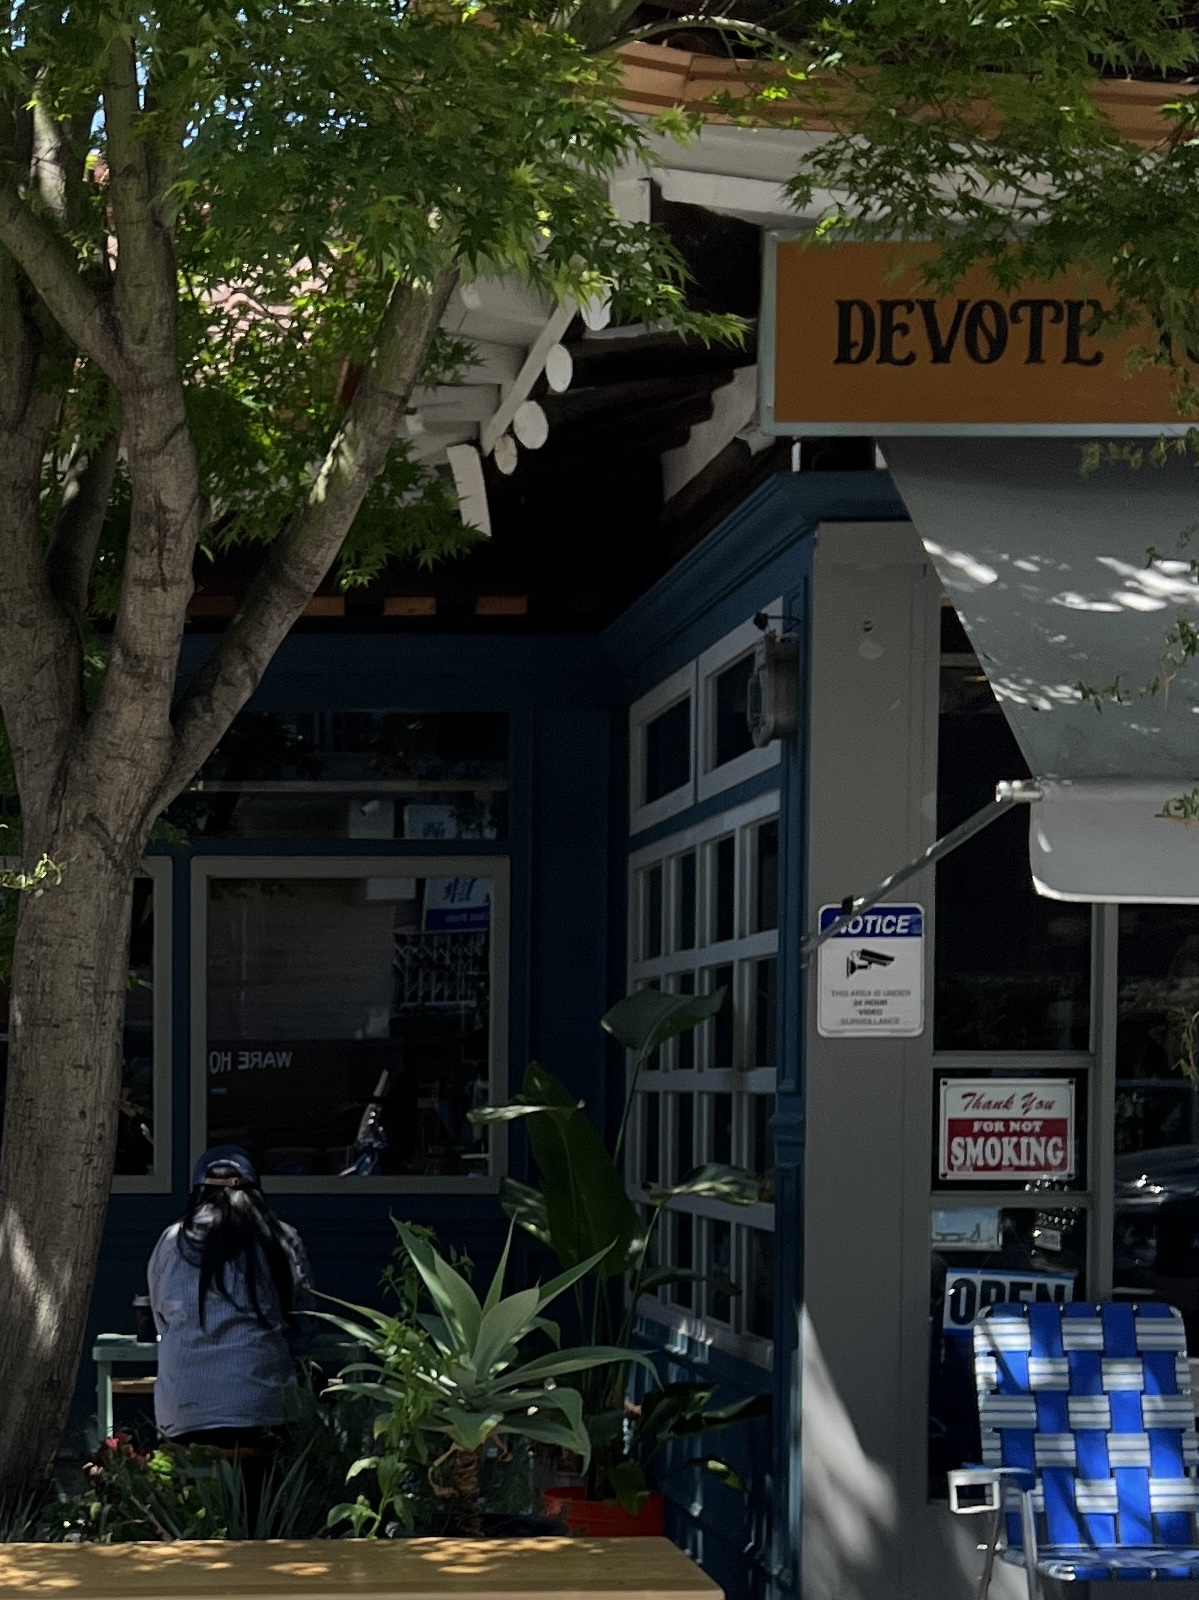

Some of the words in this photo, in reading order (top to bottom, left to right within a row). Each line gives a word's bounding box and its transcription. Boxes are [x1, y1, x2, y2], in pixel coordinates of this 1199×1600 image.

[833, 299, 1104, 366] DEVOTE
[961, 1092, 1016, 1112] Thank
[1021, 1092, 1055, 1115] You
[973, 1121, 1005, 1133] FOR
[1009, 1121, 1043, 1133] NOT
[951, 1136, 1064, 1167] SMOKING
